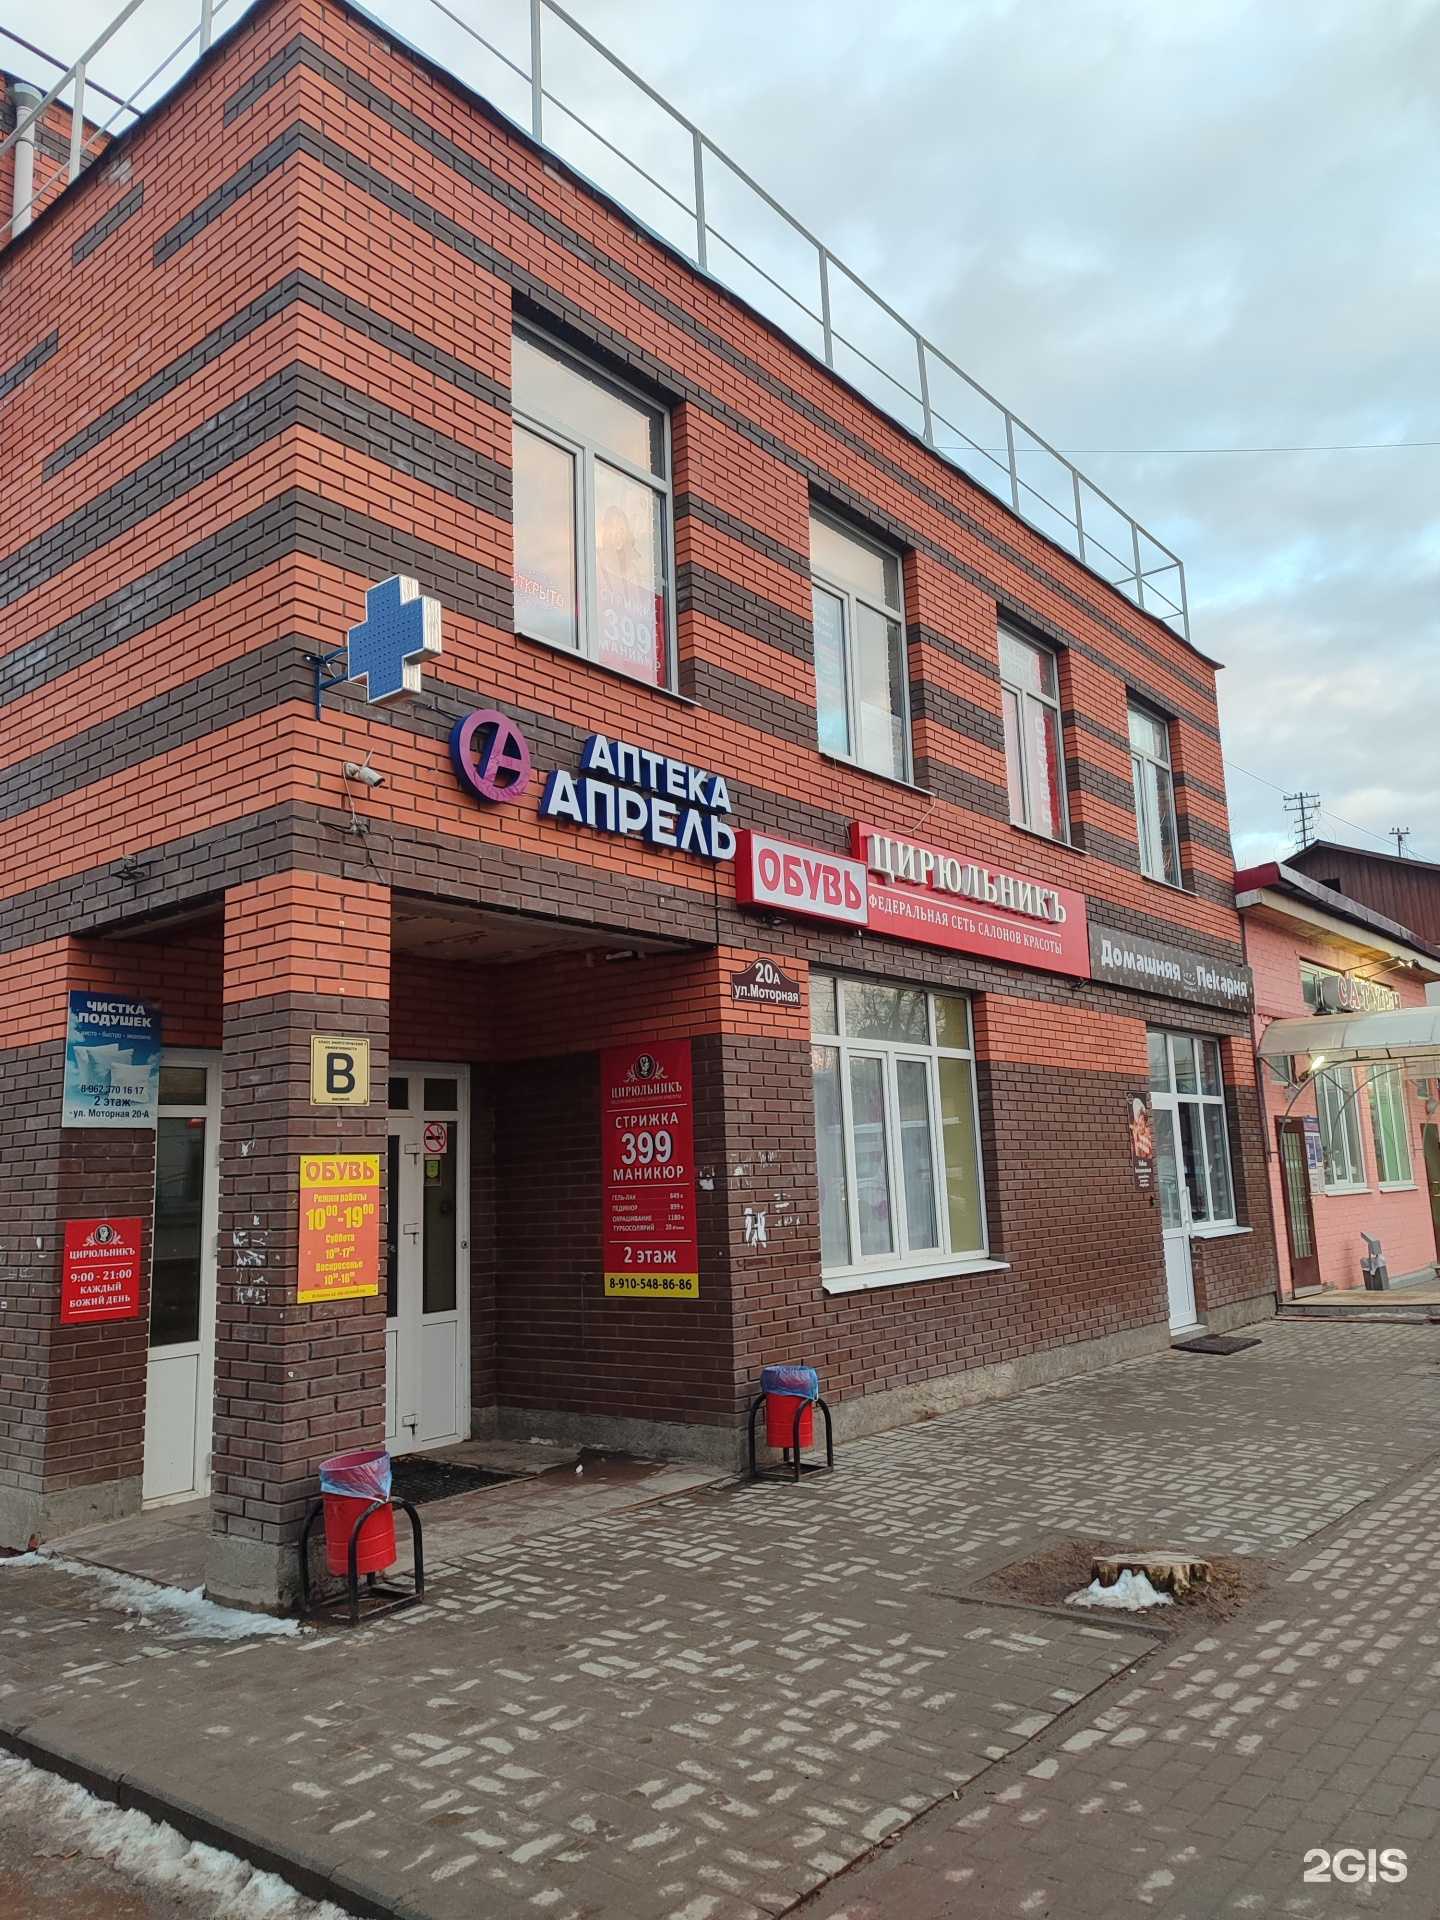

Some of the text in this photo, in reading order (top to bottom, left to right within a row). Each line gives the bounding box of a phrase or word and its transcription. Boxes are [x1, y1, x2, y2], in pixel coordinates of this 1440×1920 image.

[602, 607, 651, 656] 399
[586, 734, 732, 814] АПТЕКА
[546, 769, 737, 861] АПРЕЛЬ
[758, 848, 862, 910] ОБУВЬ
[868, 833, 1067, 924] ЦИРЮЛЬНИКЪ
[868, 894, 1063, 954] ФЕДЕРАЛЬНАЯ СЕТЬ САЛОНОВ КРАСОТЫ
[755, 962, 781, 985] 20А
[1101, 939, 1248, 1000] Домашняя Пекарня
[734, 983, 799, 1004] ул.Моторная
[86, 1000, 145, 1015] ЧИСТКА
[78, 1012, 152, 1027] ПОДУШЕК
[135, 1086, 145, 1095] 17
[611, 1081, 683, 1099] ЦИРЮЛЬНИКЪ
[94, 1096, 131, 1107] 2 этаж
[88, 1108, 130, 1119] Моторная
[615, 1111, 679, 1129] СТРИЖКА
[621, 1130, 672, 1165] 399
[306, 1161, 375, 1182] ОБУВЬ
[613, 1165, 684, 1181] МАНИКЮР
[69, 1247, 136, 1260] ЦИРЮЛЬНИКЪ
[623, 1246, 677, 1264] 2 этаж
[70, 1271, 94, 1284] 9:00
[102, 1269, 132, 1281] 21:00
[609, 1278, 692, 1290] 8-910-548-86-86
[80, 1281, 122, 1294] КАЖДЫЙ
[69, 1294, 131, 1308] БОЖИЙ ДЕНЬ
